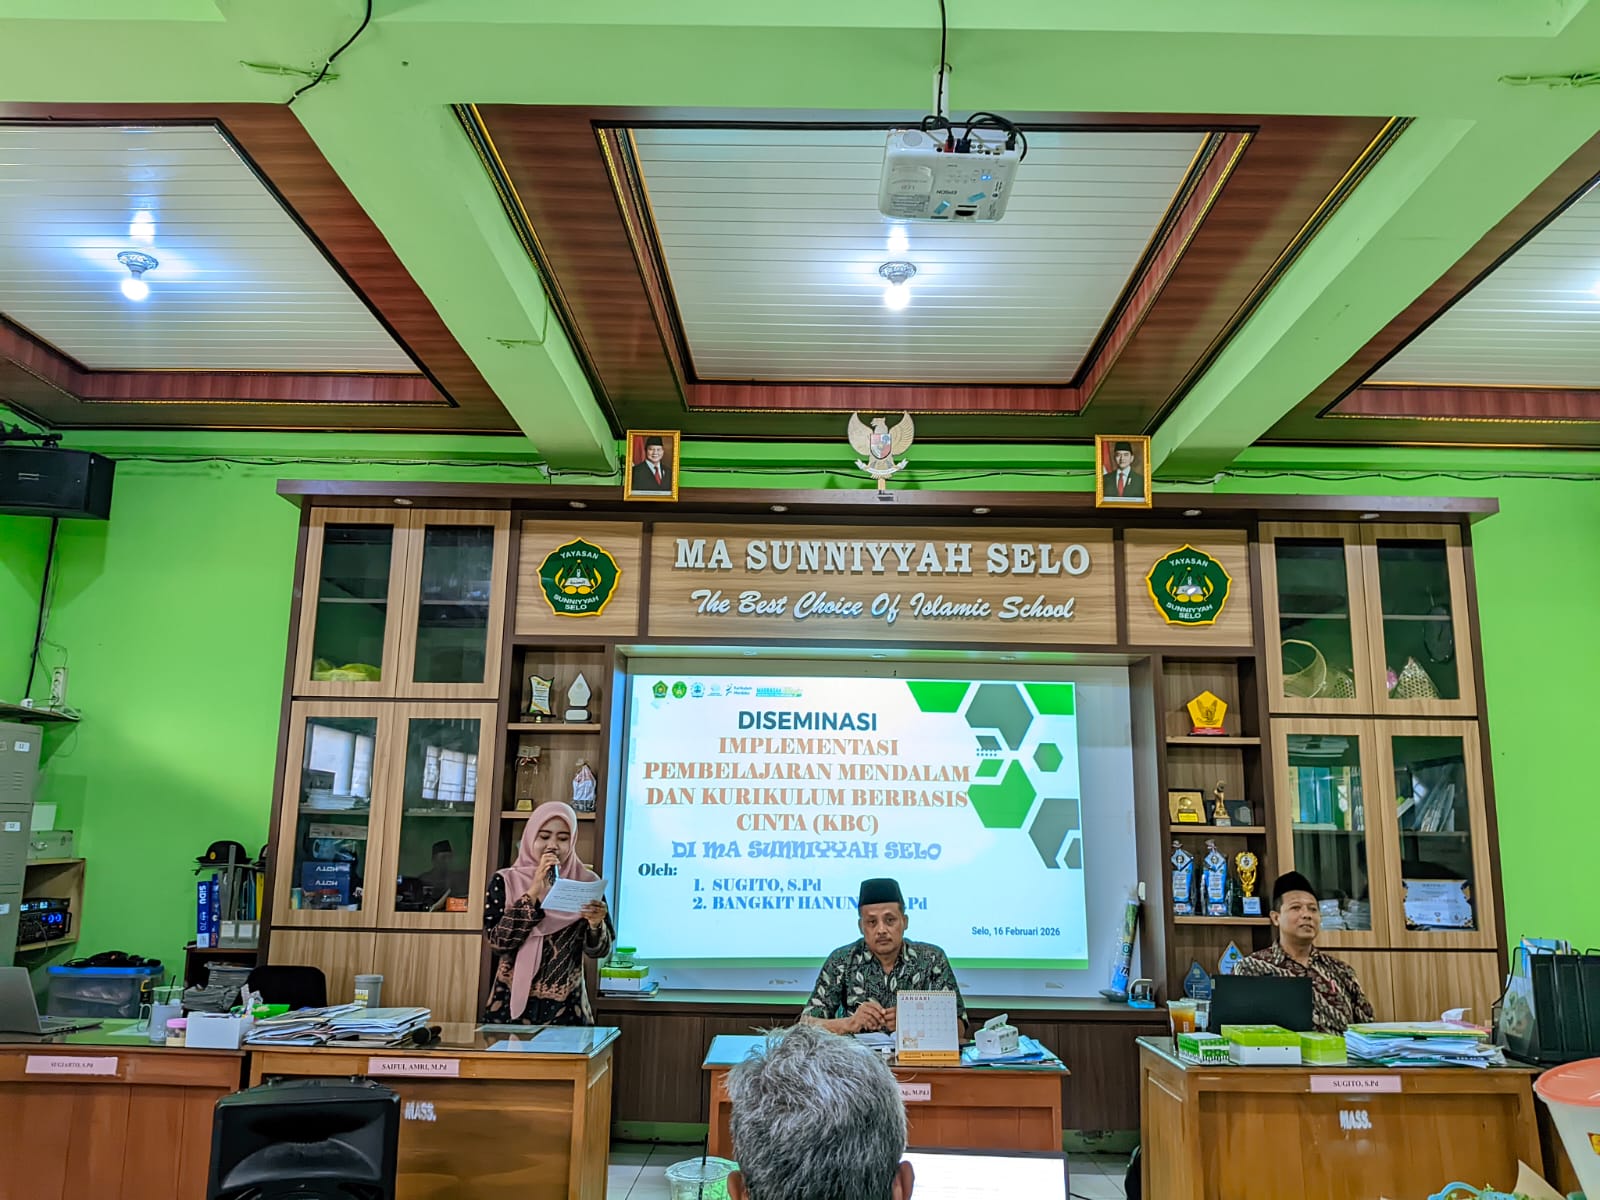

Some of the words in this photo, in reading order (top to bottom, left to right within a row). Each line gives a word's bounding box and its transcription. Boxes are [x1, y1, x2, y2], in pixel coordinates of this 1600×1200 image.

[560, 550, 599, 560] YAYASAN
[674, 538, 733, 569] MA
[746, 540, 972, 573] SUNNIYYAH
[986, 542, 1090, 576] SELO
[1169, 558, 1209, 568] YAYASAN
[553, 593, 600, 605] SUNNIYYAH
[690, 589, 731, 614] The
[737, 590, 789, 615] Best
[793, 591, 863, 619] Choice
[871, 592, 901, 624] Of
[909, 592, 991, 618] Islamic
[997, 594, 1075, 620] School
[1165, 602, 1213, 614] SUNNIYYAH
[738, 710, 877, 731] DISEMINASI
[718, 736, 899, 756] IMPLEMENTASI
[642, 761, 832, 781] PEMBELAJARAN
[837, 763, 971, 783] MENDALAM
[645, 787, 696, 805] DAN
[701, 787, 847, 806] KURIKULUM
[851, 788, 969, 808] BERBASIS
[736, 813, 807, 832] CINTA
[812, 813, 879, 836] (KBC)
[671, 840, 696, 858] DI
[747, 840, 878, 860] SUNNIYYAH
[884, 841, 942, 861] SELO
[638, 863, 678, 877] Oleh:
[693, 878, 705, 892] 1.
[711, 878, 784, 893] SUGITO,
[787, 878, 822, 892] S.Pd
[692, 896, 707, 910] 2.
[712, 896, 794, 910] BANGKIT
[798, 896, 859, 910] HANUN
[904, 897, 928, 910] .Pd
[971, 926, 992, 937] Selo,
[994, 926, 1004, 936] 16
[1005, 926, 1039, 937] Februari
[1040, 927, 1061, 937] 2026
[409, 1063, 430, 1071] AMRI,
[1333, 1080, 1364, 1088] SUGITO,
